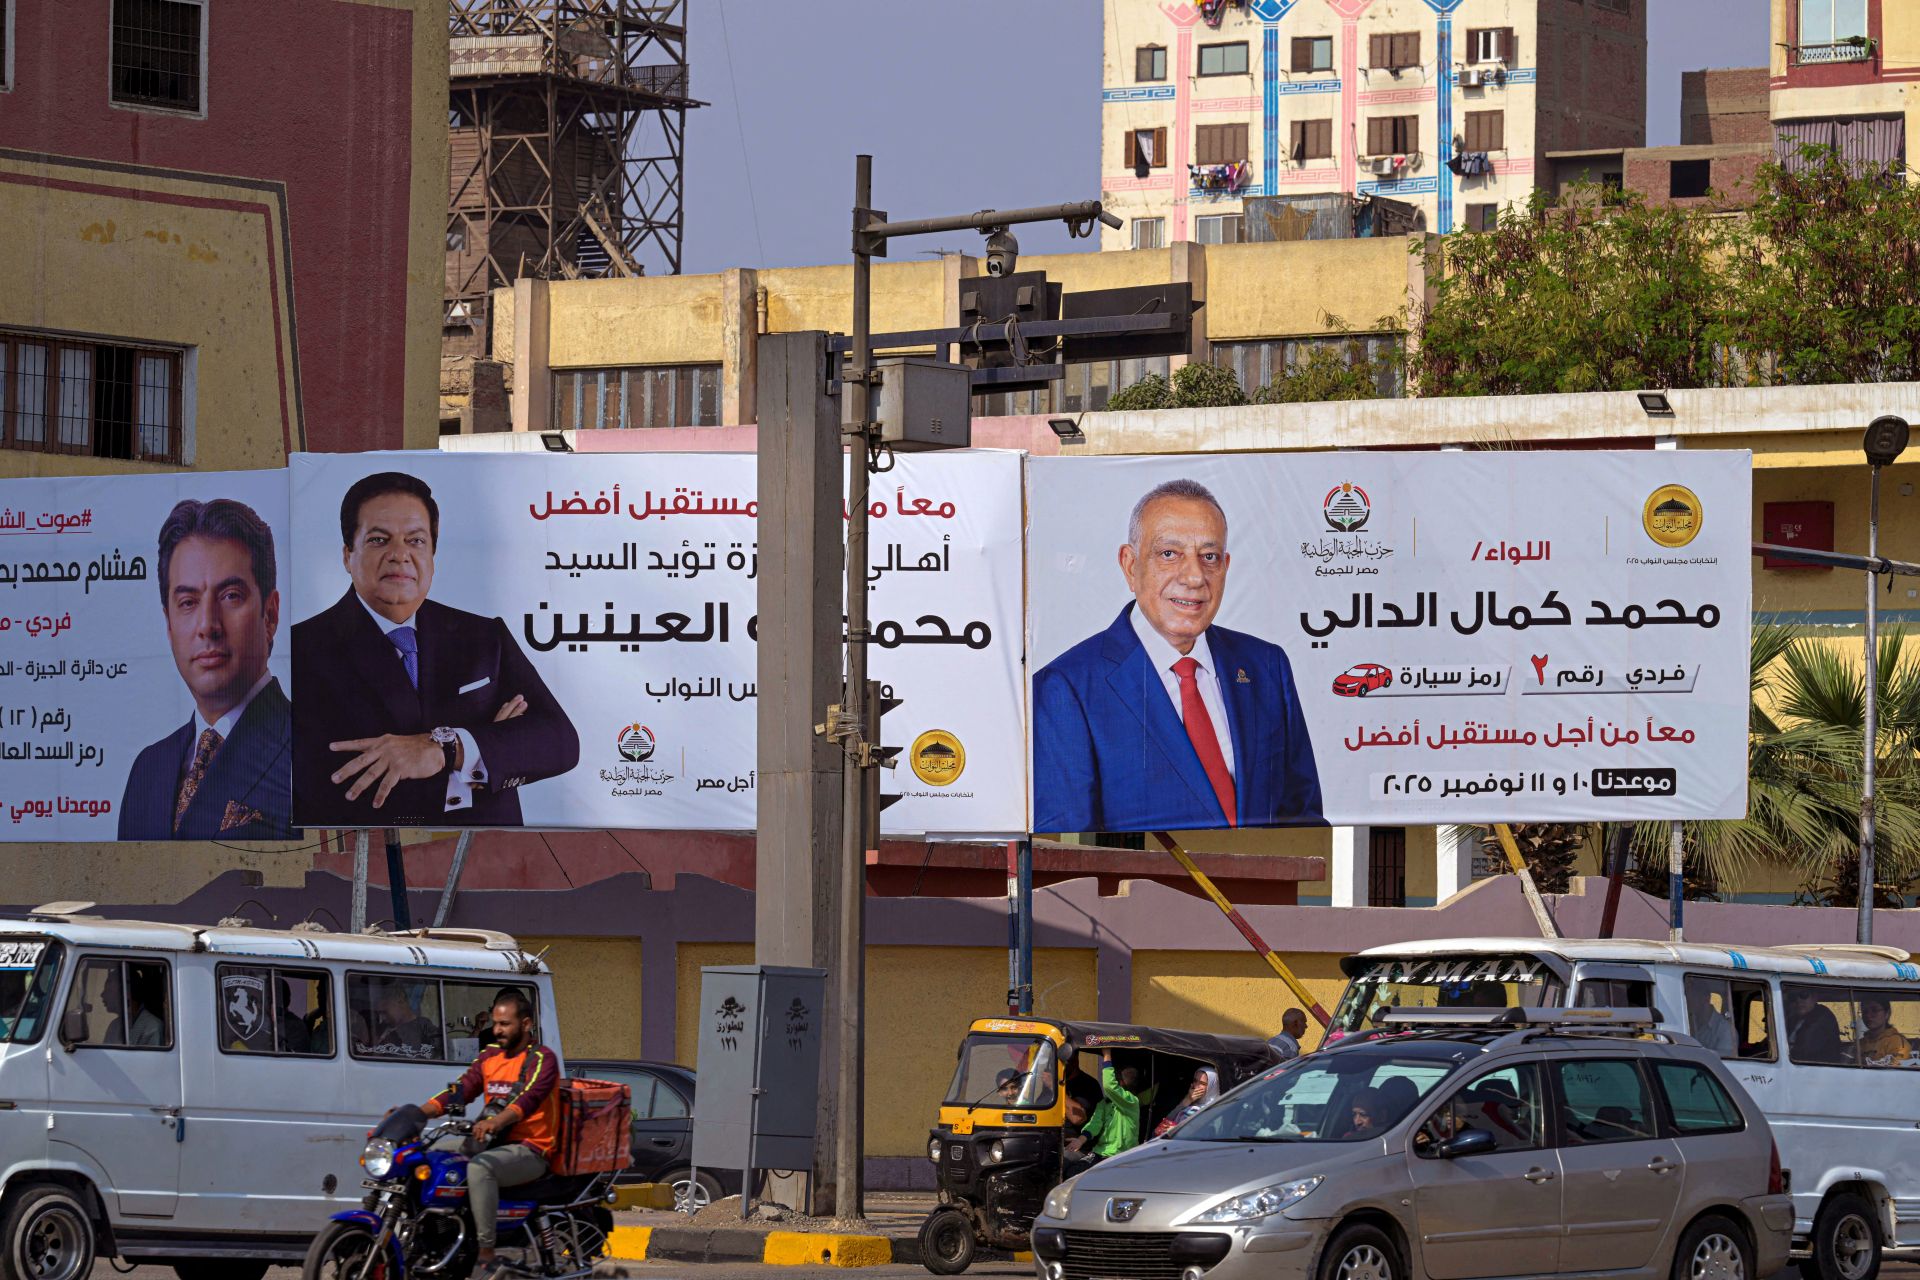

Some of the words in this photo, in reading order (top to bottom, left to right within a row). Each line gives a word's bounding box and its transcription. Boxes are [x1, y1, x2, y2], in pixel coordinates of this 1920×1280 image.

[530, 484, 620, 520] أفضل
[843, 498, 887, 520] م
[897, 486, 955, 518] معاً
[0, 508, 91, 533] #صوت_الش
[545, 543, 636, 577] السيد
[648, 540, 715, 578] تؤيد
[867, 535, 950, 590] أهالي
[1640, 557, 1662, 566] النواب
[1662, 557, 1689, 566] مجلس
[22, 562, 80, 582] محمد
[85, 548, 146, 594] هشام
[1314, 565, 1354, 577] للجميع
[1355, 567, 1379, 576] مصر
[26, 612, 70, 637] فردي
[1300, 592, 1437, 648] الدالي
[1451, 591, 1571, 635] كمال
[1586, 599, 1720, 629] محمد
[524, 602, 729, 652] العينين
[843, 614, 991, 650] محم
[26, 661, 65, 681] الجيزة
[71, 660, 103, 681] دائرة
[106, 663, 127, 678] عن
[1400, 667, 1461, 688] سيارة
[1468, 667, 1500, 687] رمز
[1531, 654, 1548, 685] ٢
[1556, 664, 1604, 686] رقم
[1625, 664, 1686, 690] فردي
[646, 677, 720, 702] النواب
[41, 708, 70, 733] رقم
[1544, 717, 1593, 747] أجل
[1647, 717, 1695, 743] معاً
[1345, 719, 1419, 751] أفضل
[1427, 722, 1536, 749] مستقبل
[1600, 722, 1639, 747] من
[0, 742, 30, 759] العا
[35, 742, 73, 759] السد
[75, 744, 103, 767] رمز
[611, 787, 643, 797] للجميع
[643, 789, 663, 797] مصر
[695, 778, 726, 792] مصر
[727, 771, 754, 792] أجل
[1384, 775, 1431, 794] ٢٠٢٥
[1441, 773, 1524, 797] نوفمبر
[1553, 778, 1565, 795] و
[1598, 772, 1670, 792] موعدنا
[929, 791, 950, 799] مجلس
[11, 801, 52, 823] يومي
[58, 797, 110, 817] موعدنا
[1355, 960, 1544, 984] AYMAN
